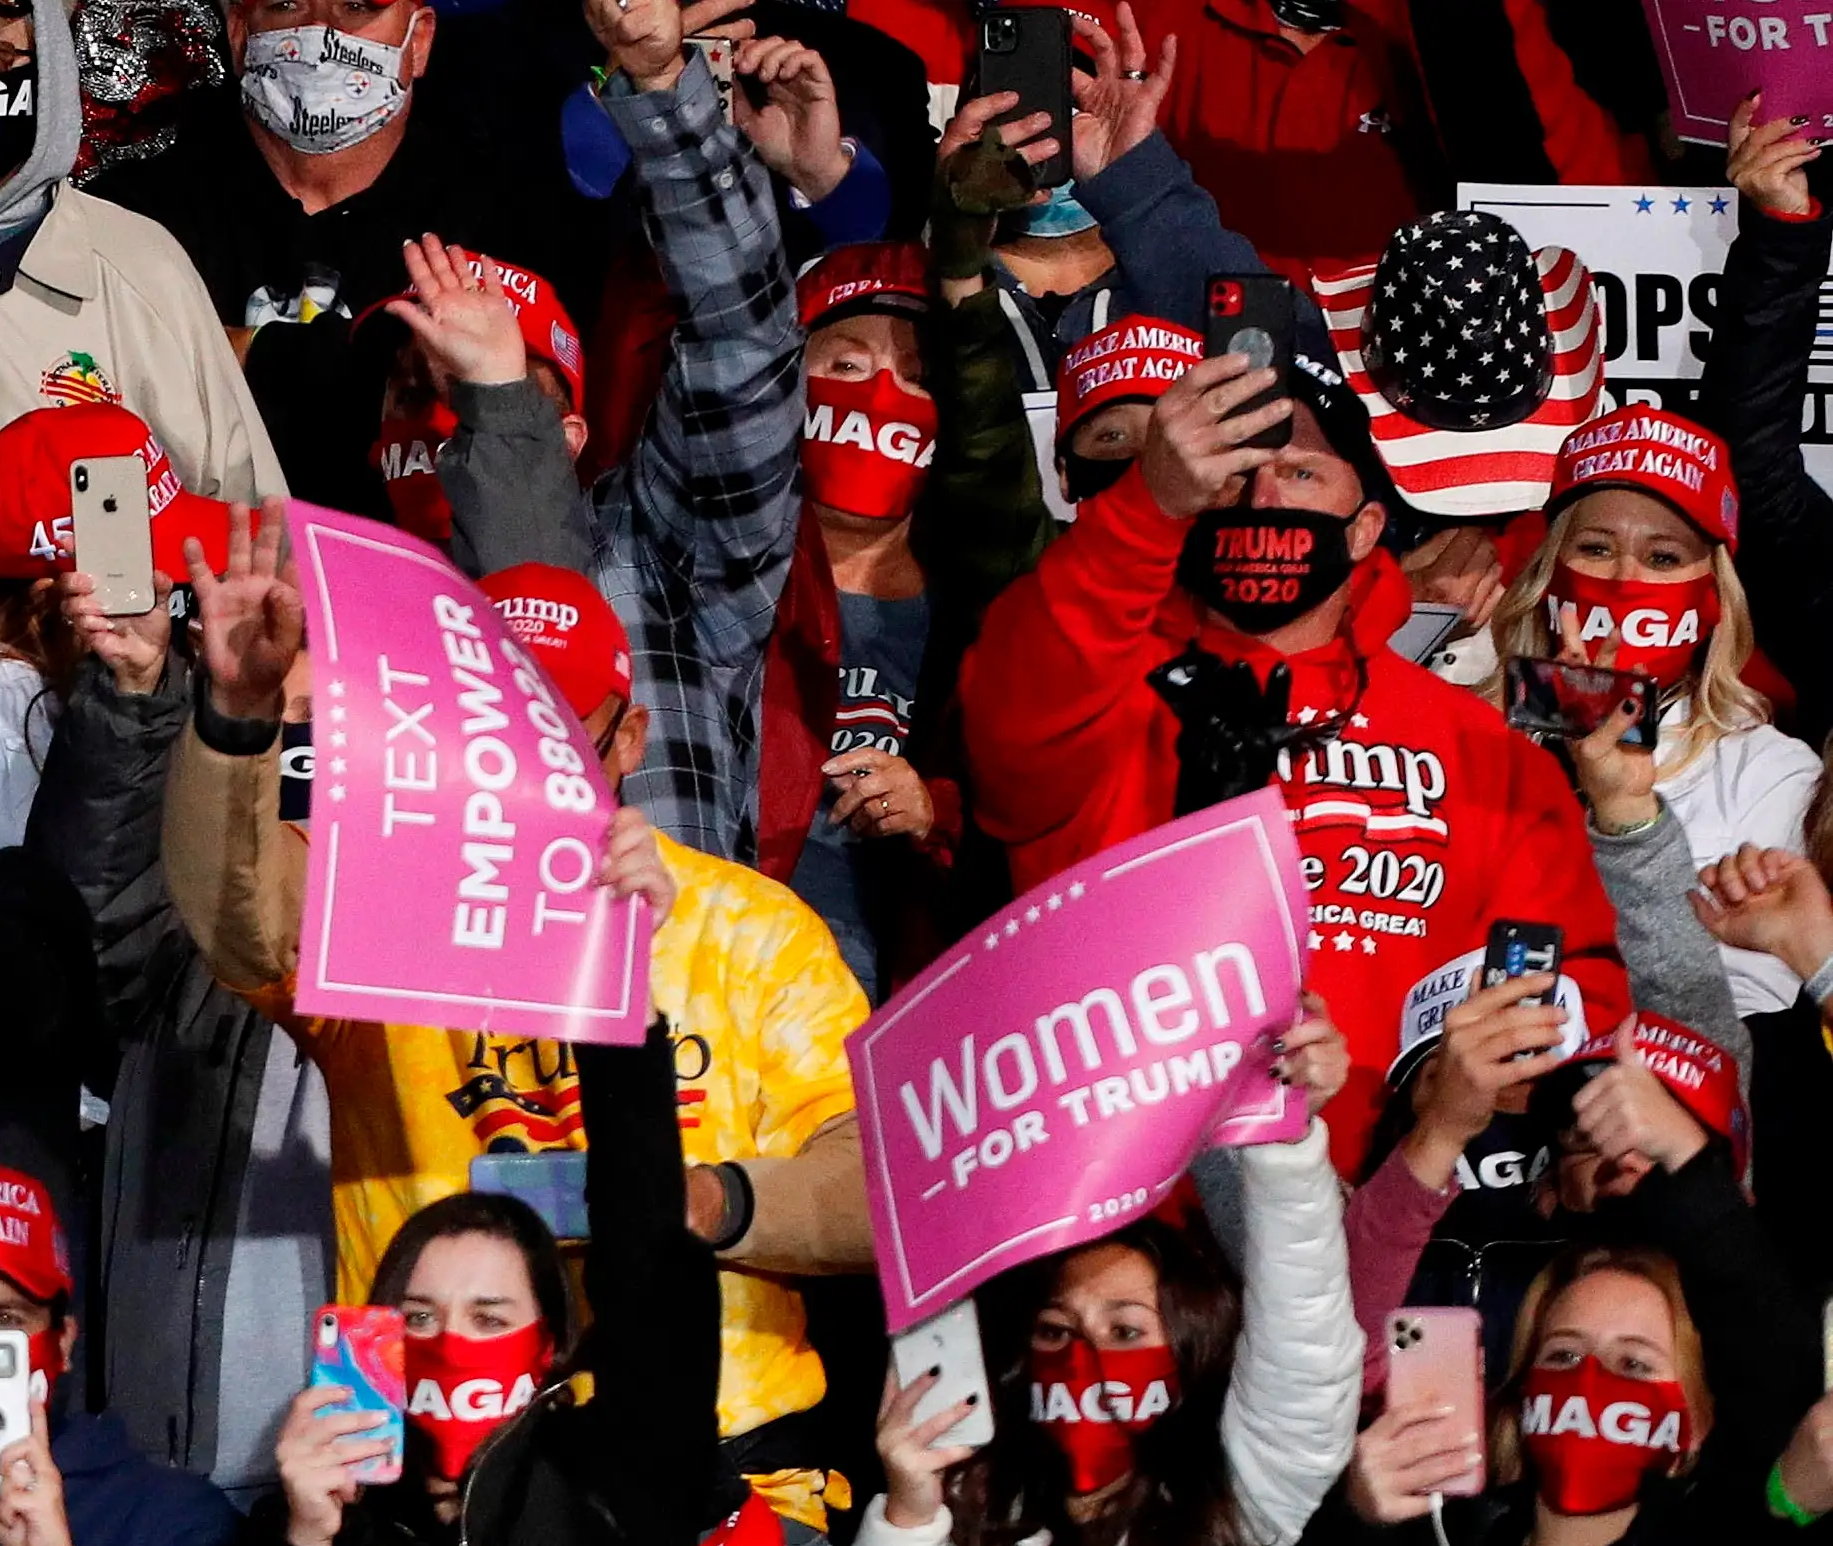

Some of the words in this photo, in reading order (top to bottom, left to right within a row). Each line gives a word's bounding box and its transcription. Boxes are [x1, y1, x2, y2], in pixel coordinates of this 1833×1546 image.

[319, 27, 383, 74] Steelers
[1706, 15, 1791, 50] FOR
[1591, 271, 1725, 363] OPS
[1065, 329, 1120, 375] MAKE
[1120, 326, 1204, 358] AMERIC
[1077, 357, 1137, 398] GREAT
[804, 405, 937, 469] MAGA
[1564, 421, 1623, 458] MAKE
[1623, 416, 1717, 472] AMERICA
[1573, 448, 1639, 482] GREAT
[1638, 449, 1704, 493] AGAIN
[1215, 527, 1314, 561] TRUMP
[494, 597, 579, 632] ump
[1221, 579, 1299, 604] 2020
[507, 619, 545, 633] 020
[380, 654, 438, 837] TEXT
[435, 594, 517, 949] EMPOWER
[533, 836, 594, 935] TO
[1410, 968, 1465, 1010] MAKE
[899, 941, 1268, 1161] Women
[1635, 1023, 1723, 1073] MERICA
[951, 1110, 1051, 1189] FOR
[1059, 1040, 1243, 1127] TRUMP
[1087, 1186, 1148, 1223] 2020
[405, 1373, 536, 1423] AGA
[1524, 1395, 1681, 1453] MAGA
